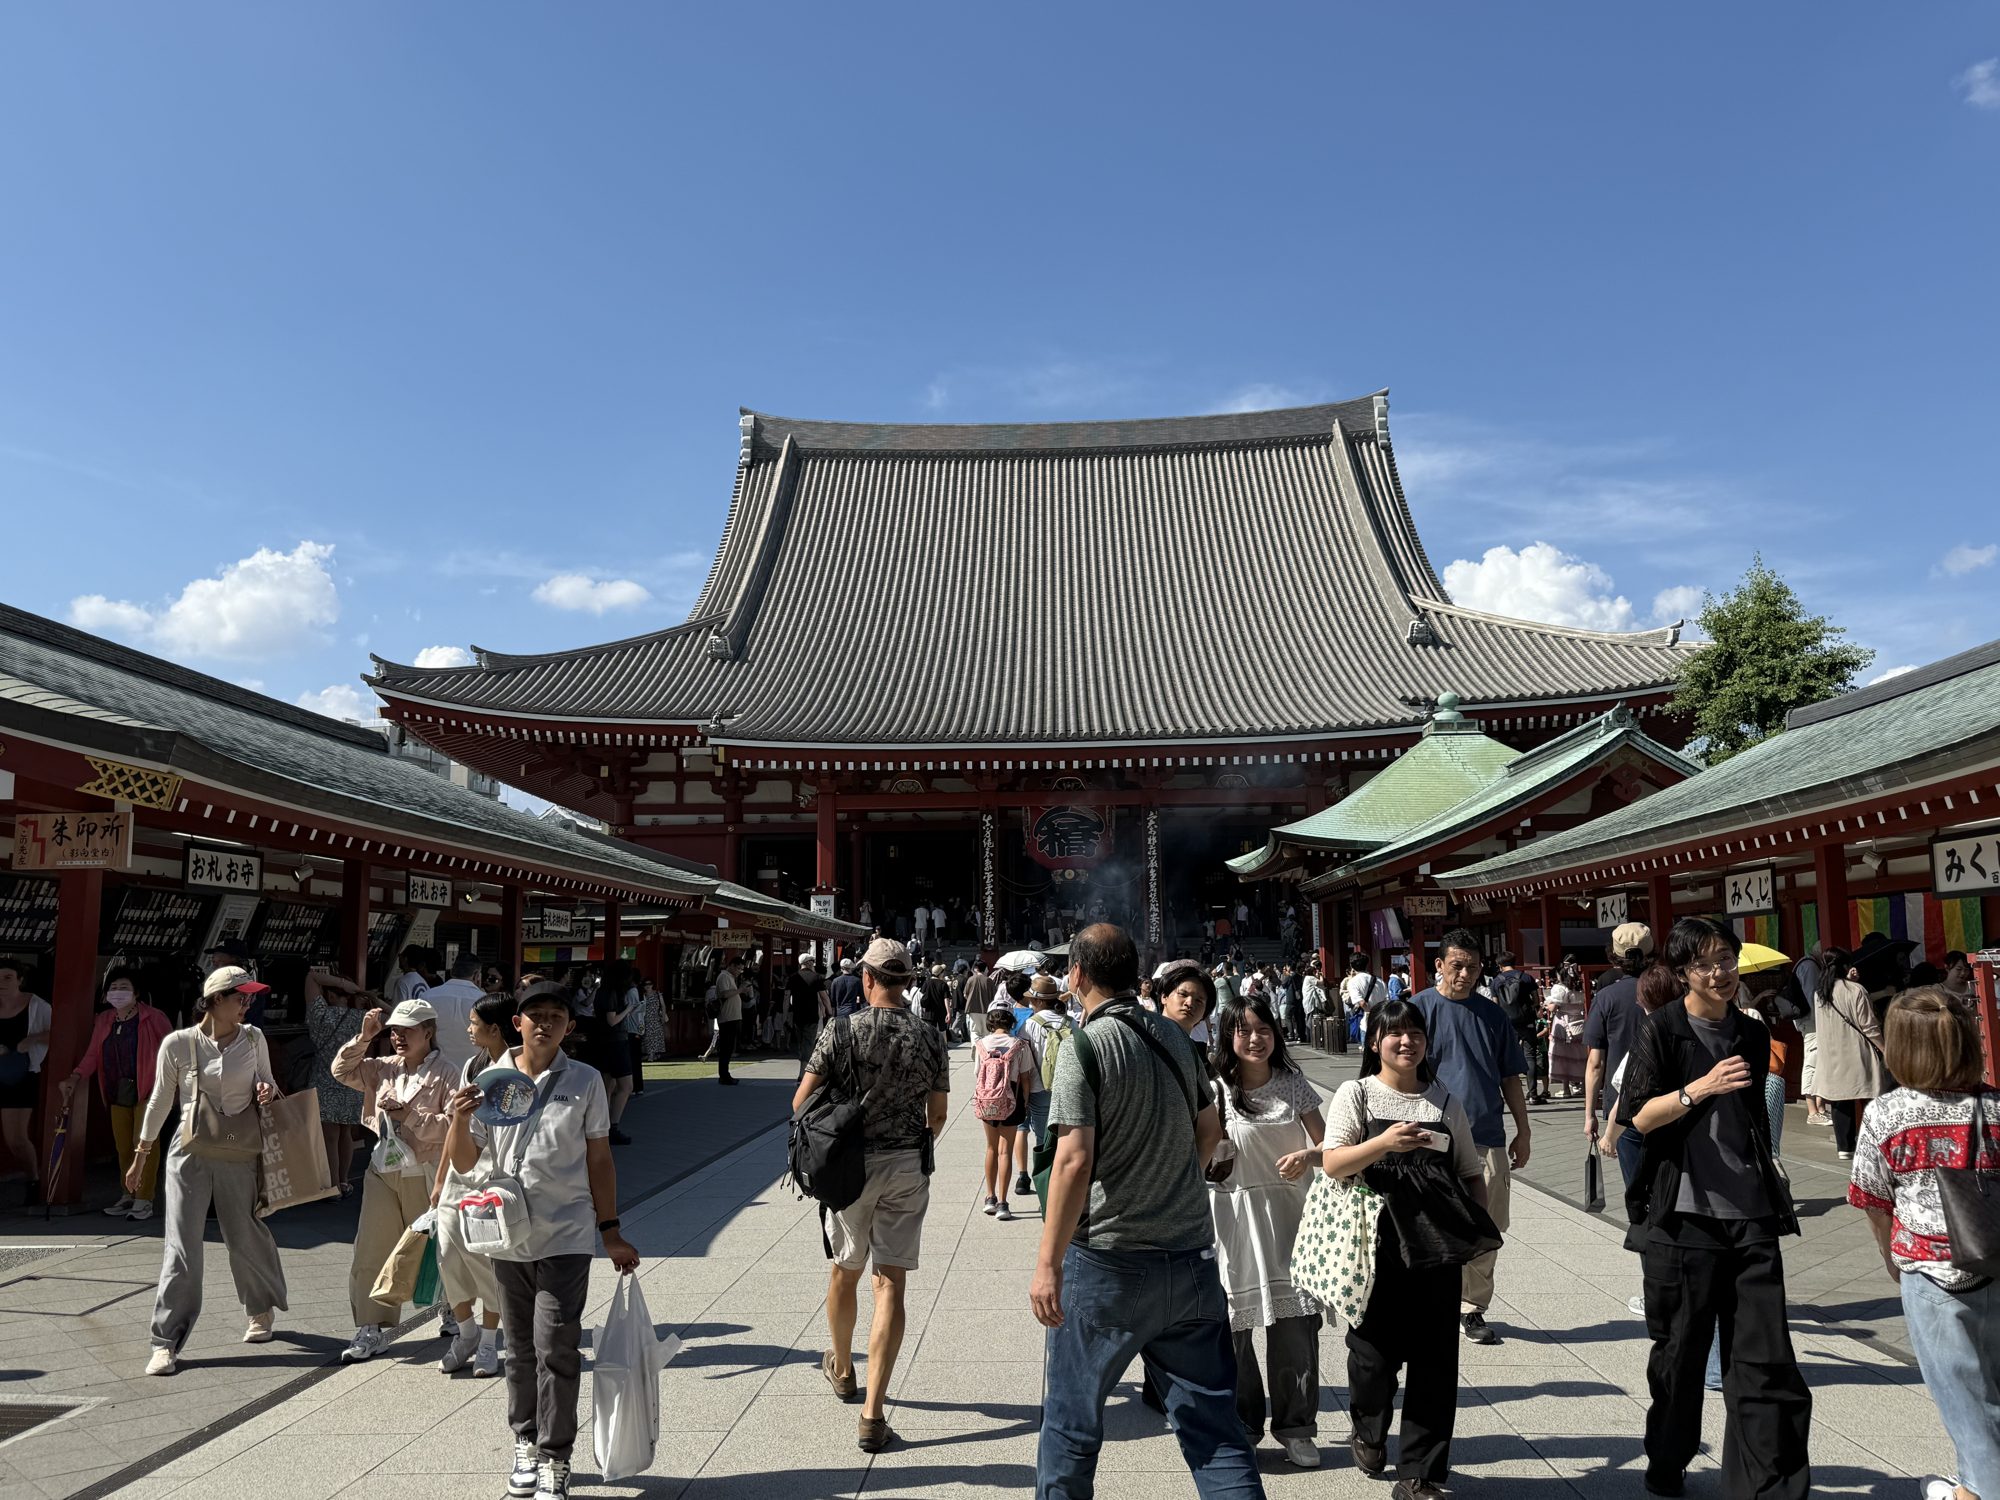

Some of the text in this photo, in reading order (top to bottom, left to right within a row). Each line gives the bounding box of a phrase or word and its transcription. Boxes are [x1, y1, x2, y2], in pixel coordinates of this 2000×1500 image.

[52, 815, 124, 848] 朱印所
[191, 853, 254, 887] お札お守
[1944, 840, 2000, 883] みく
[411, 878, 448, 904] お札お守
[1418, 896, 1444, 909] 朱印所
[1730, 876, 1769, 906] みくじ
[1600, 898, 1626, 923] みくじ
[265, 1168, 290, 1191] BC
